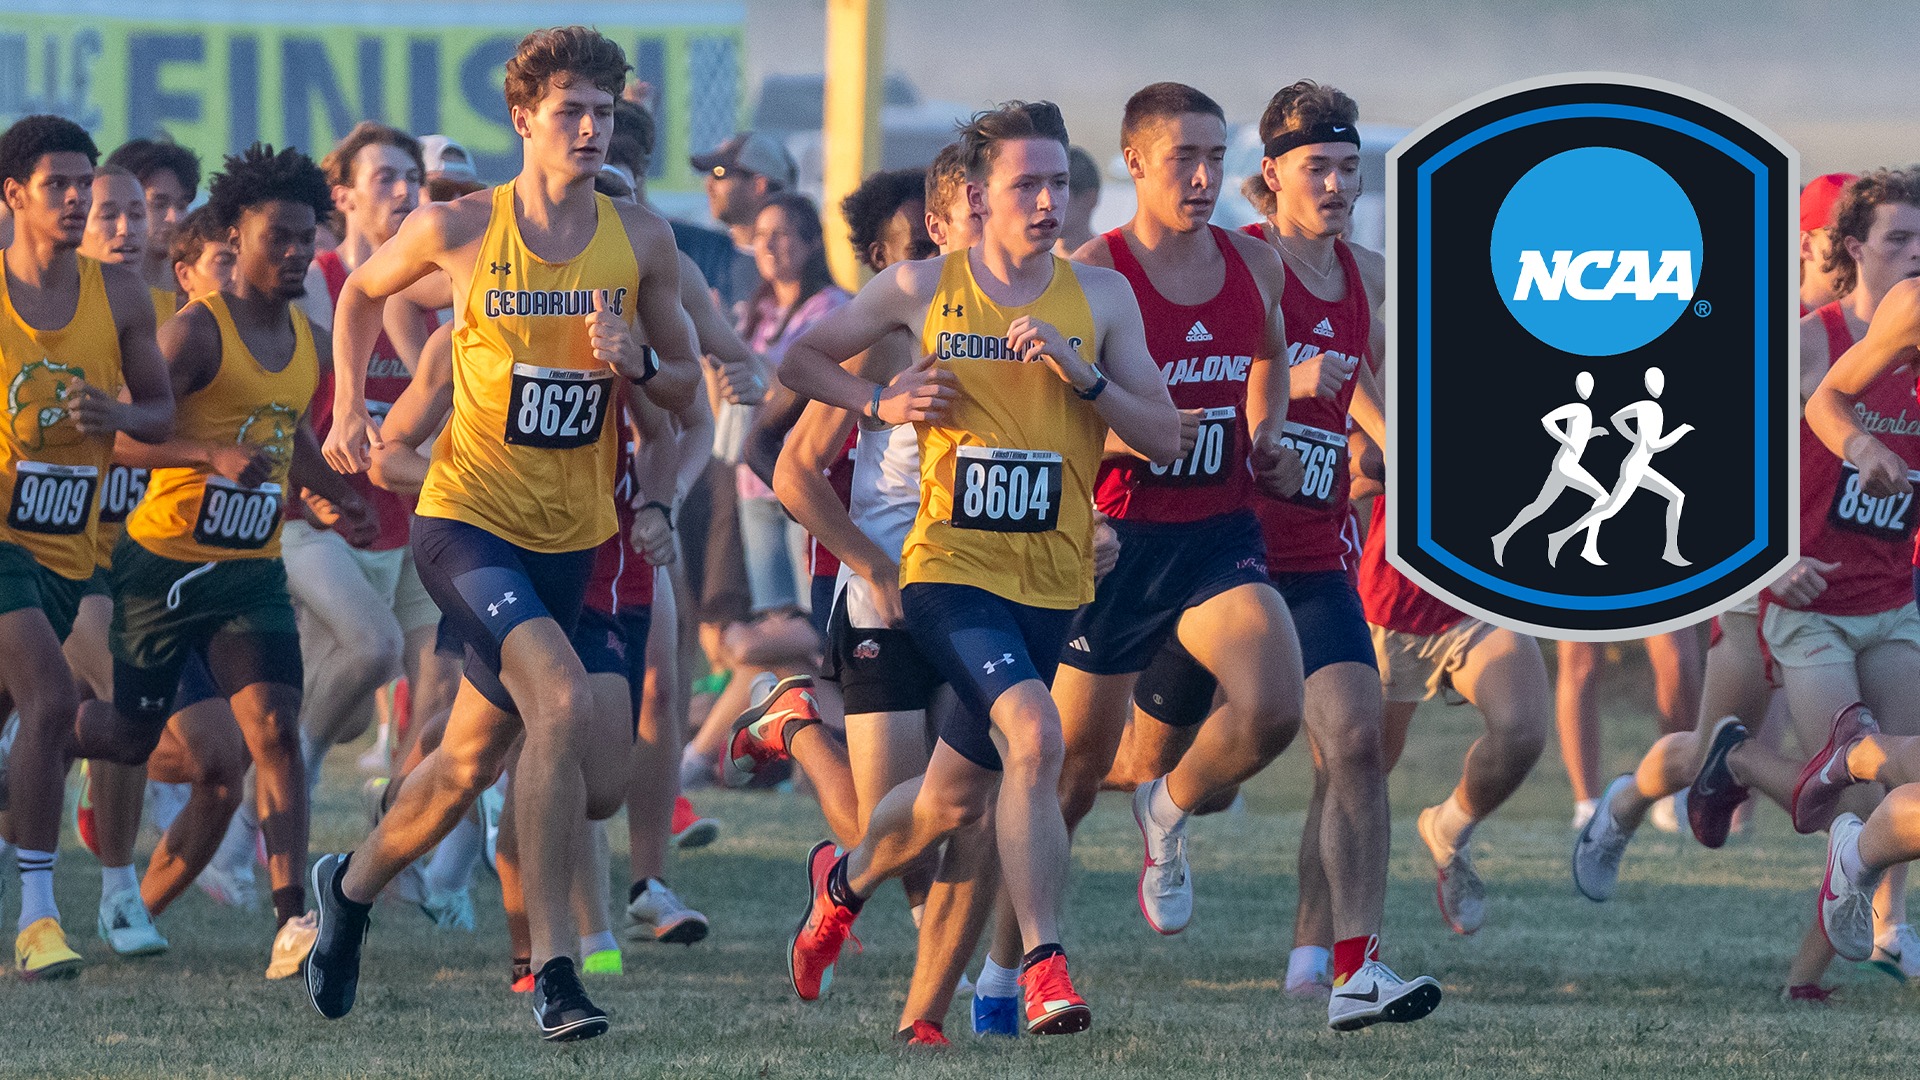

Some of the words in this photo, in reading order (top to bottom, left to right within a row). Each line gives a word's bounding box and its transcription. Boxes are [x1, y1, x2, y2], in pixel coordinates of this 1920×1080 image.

[936, 331, 1082, 362] CEDARV
[517, 381, 602, 436] 8623
[1149, 423, 1224, 476] 70
[1280, 436, 1337, 500] 766
[16, 475, 89, 526] 9009
[203, 489, 277, 540] 9008
[963, 462, 1051, 520] 8604
[1838, 473, 1913, 530] 8902
